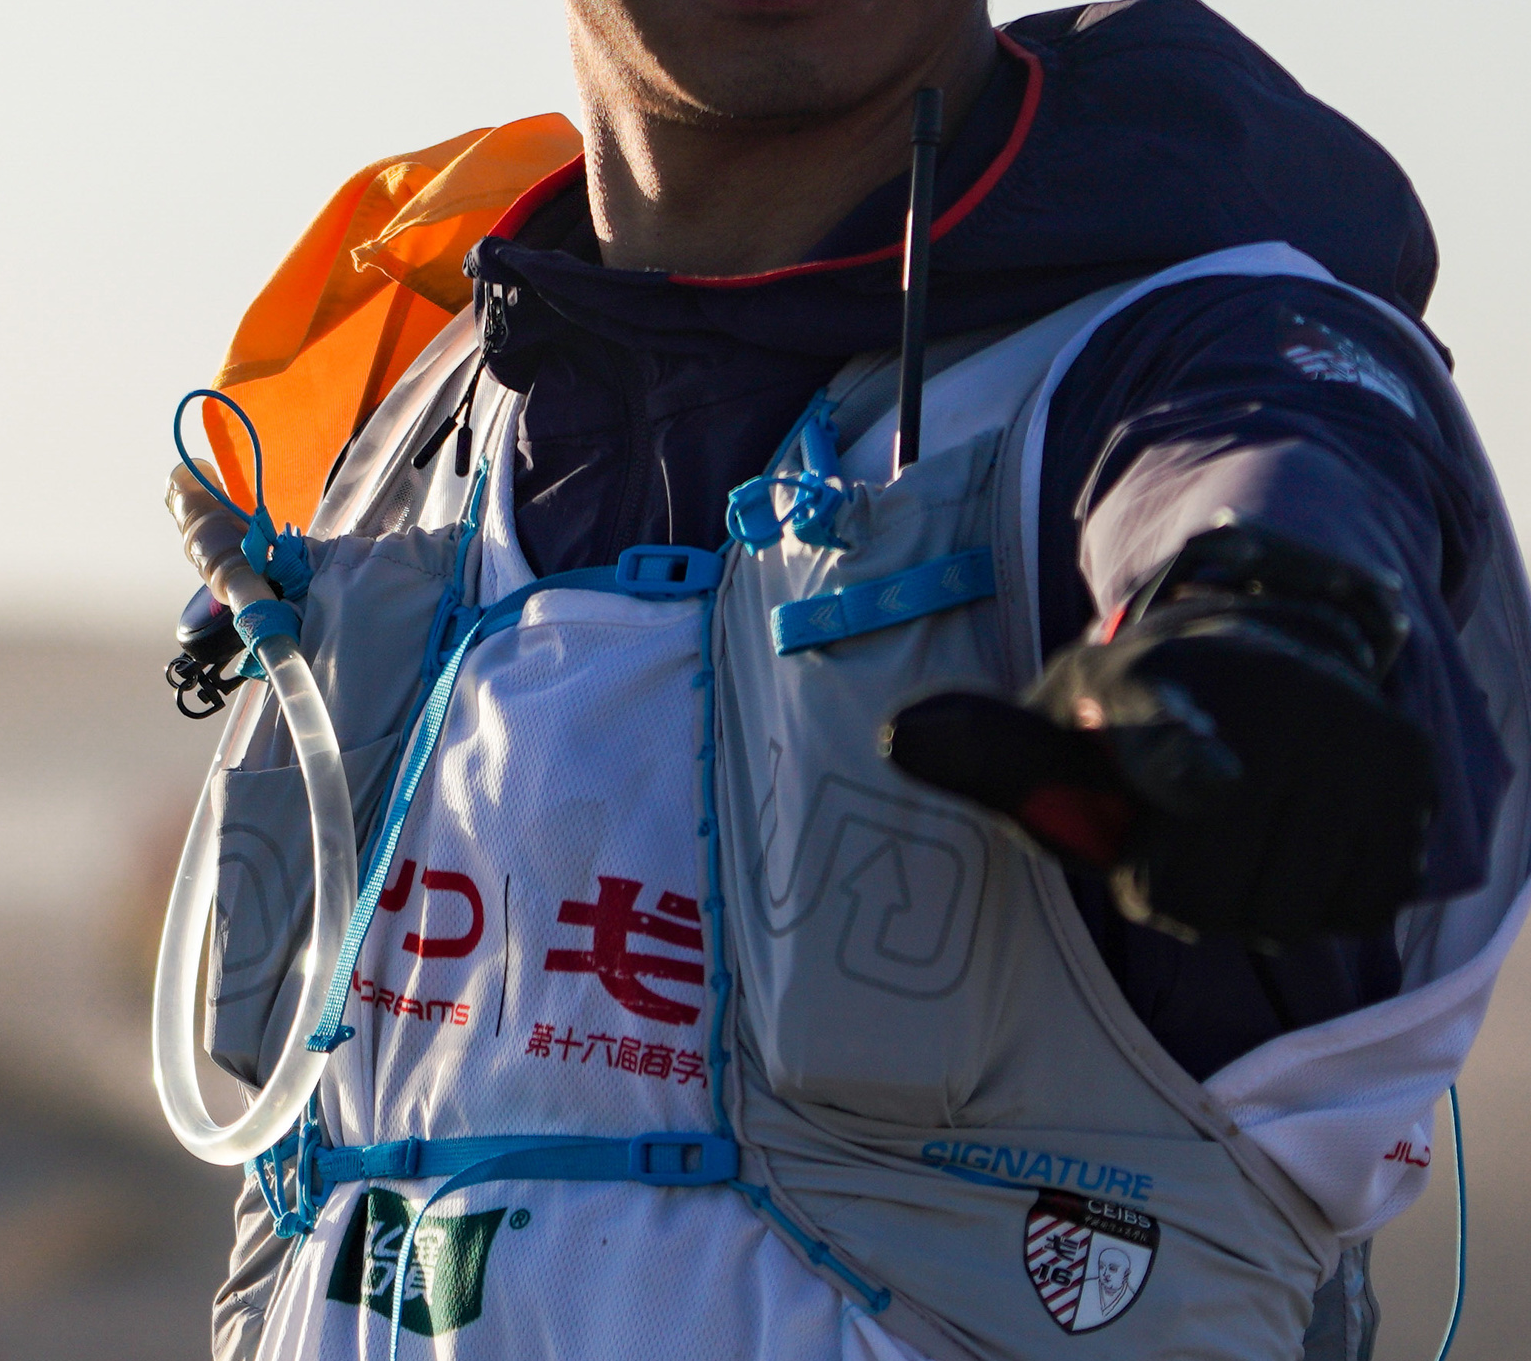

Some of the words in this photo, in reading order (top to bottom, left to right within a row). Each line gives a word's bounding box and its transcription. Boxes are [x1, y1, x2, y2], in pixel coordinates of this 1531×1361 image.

[525, 1022, 708, 1089] 第十六届商学
[922, 1140, 1153, 1201] SIGNATURE
[1087, 1199, 1150, 1229] CEIBS
